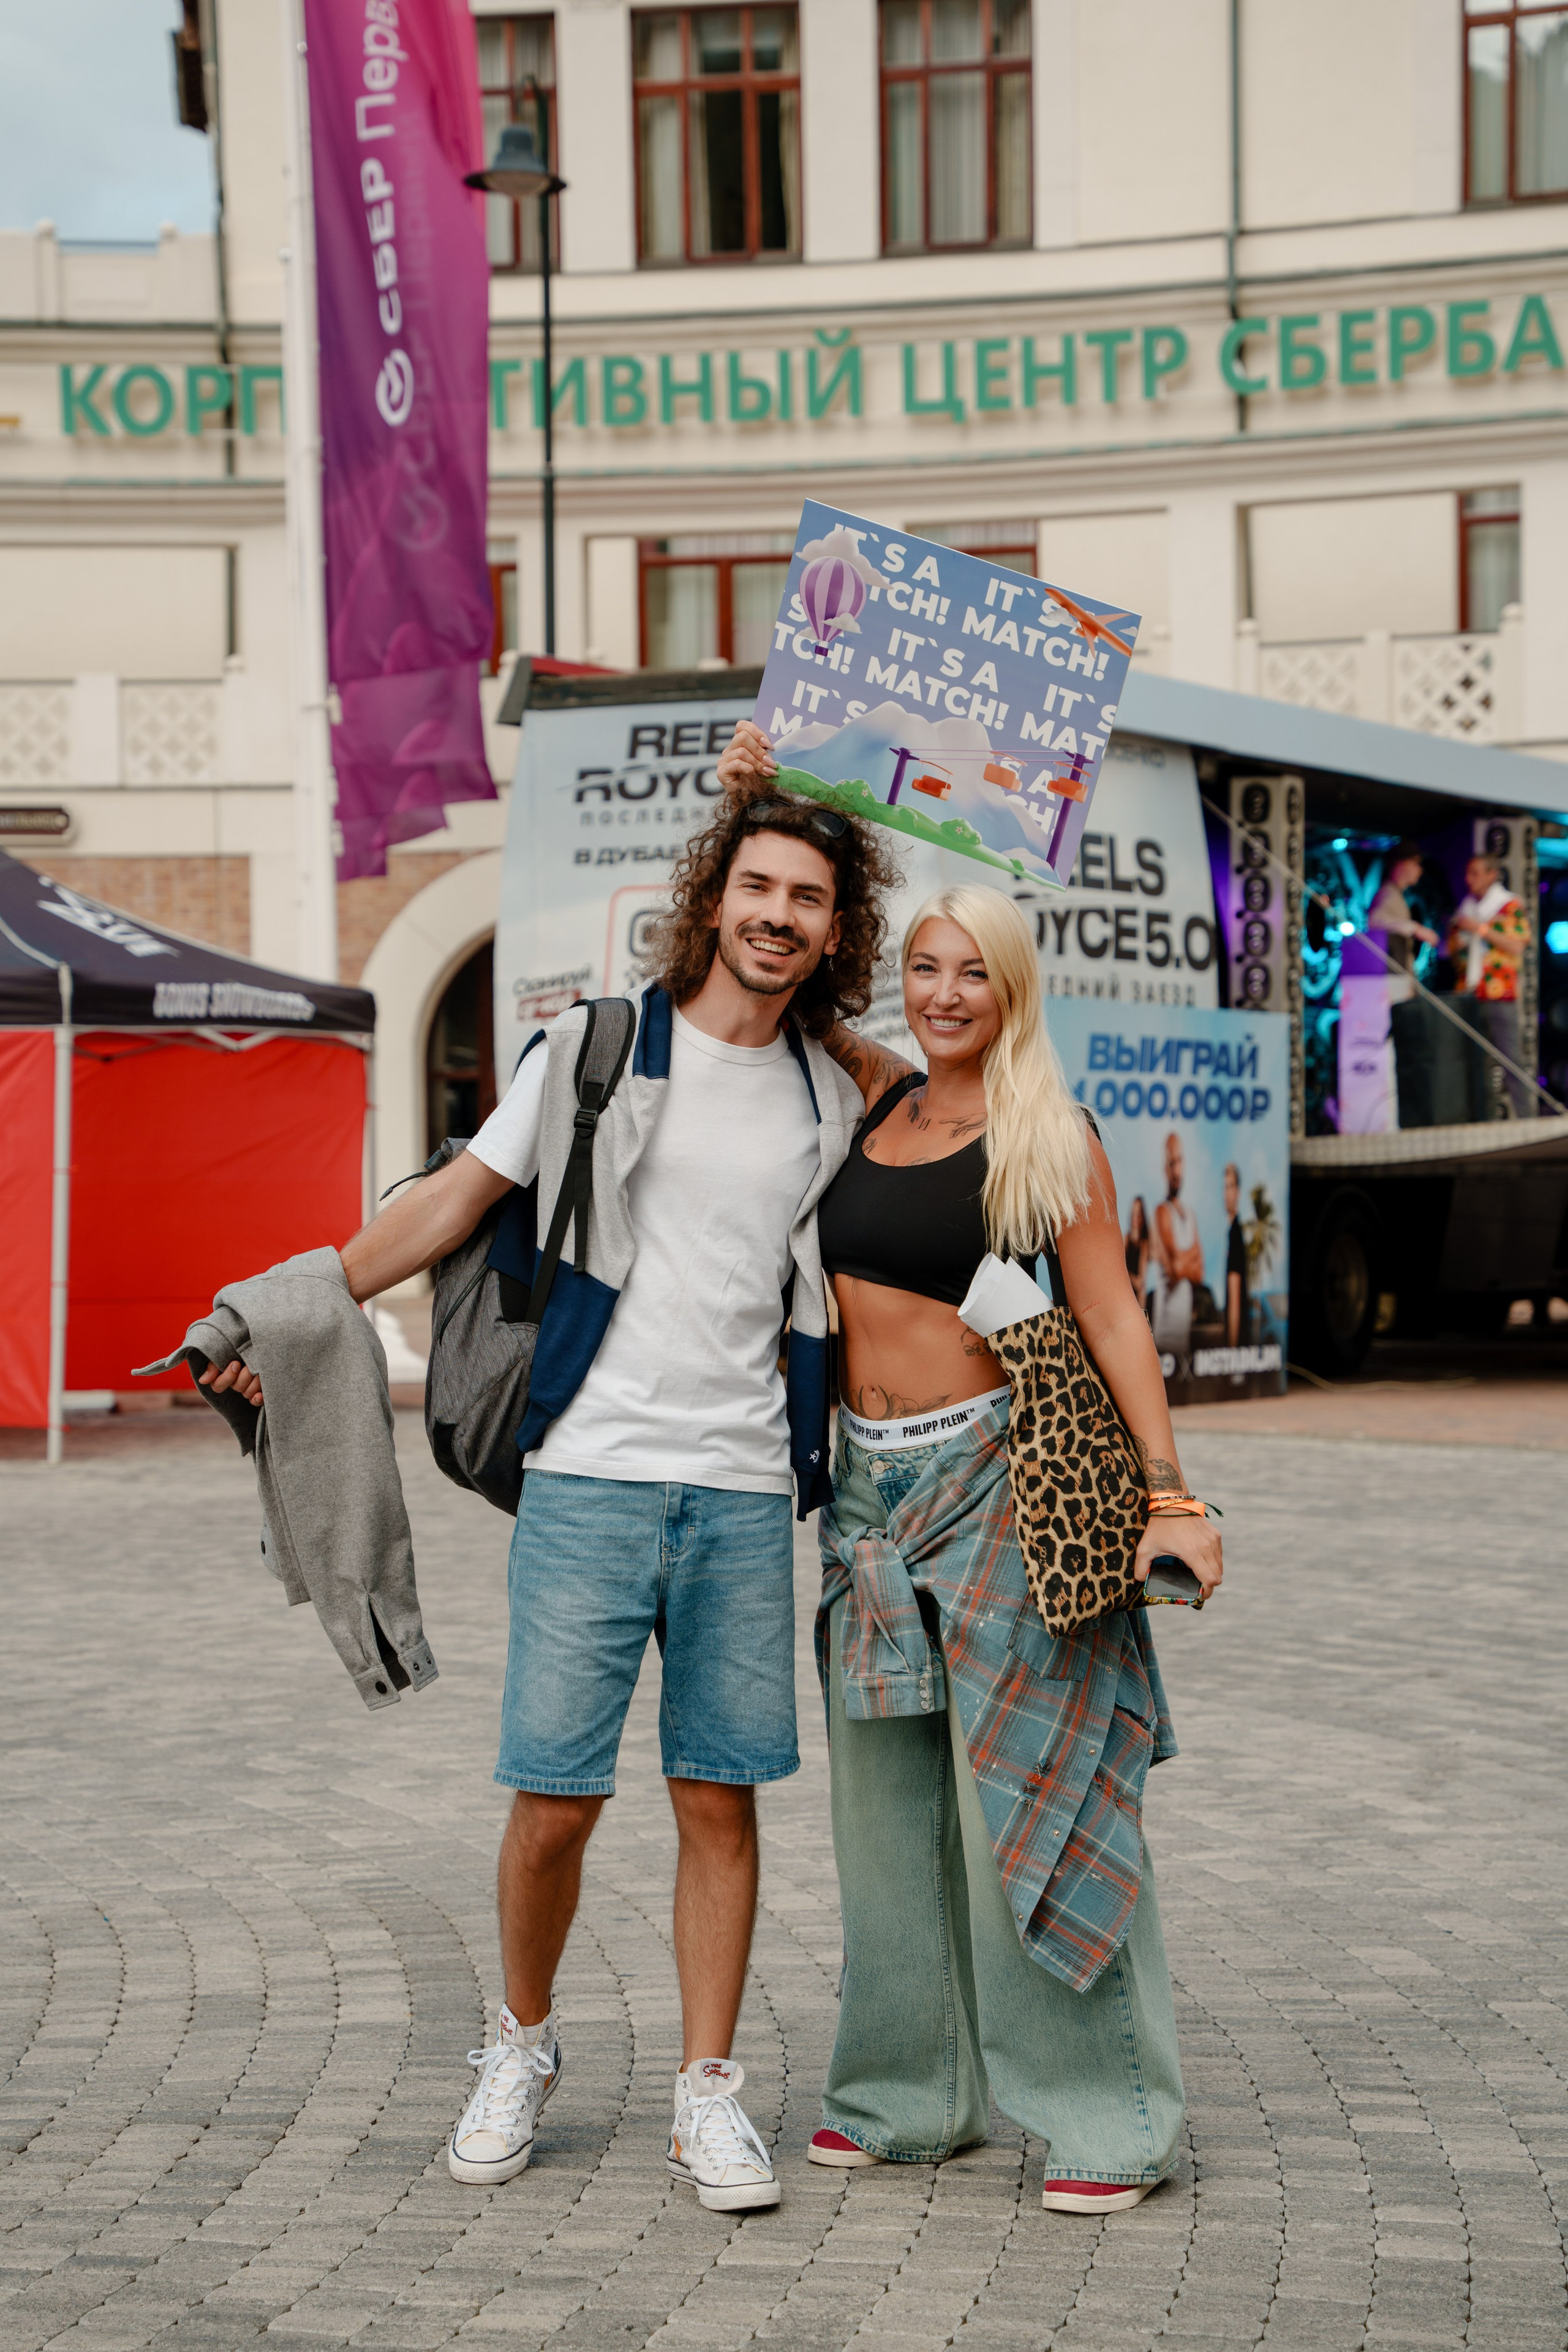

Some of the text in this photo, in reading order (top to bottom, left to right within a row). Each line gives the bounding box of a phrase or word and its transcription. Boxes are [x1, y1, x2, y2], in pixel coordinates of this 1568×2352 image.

[902, 326, 1189, 423] ЦЕНТР
[1219, 294, 1566, 396] СБЕРБА
[911, 555, 941, 588] A
[869, 575, 951, 625] TCH!
[961, 606, 1110, 681] MATCH!
[865, 655, 1010, 731] MATCH!
[970, 660, 999, 693] A
[628, 717, 752, 758] REE
[1019, 711, 1107, 761] MAT
[574, 764, 725, 803] ROYC
[1070, 833, 1165, 896] ELS
[1088, 1033, 1259, 1079] ВЫИГРАЙ
[850, 1418, 865, 1437] PHILIPP
[903, 1420, 938, 1438] PHILIPP
